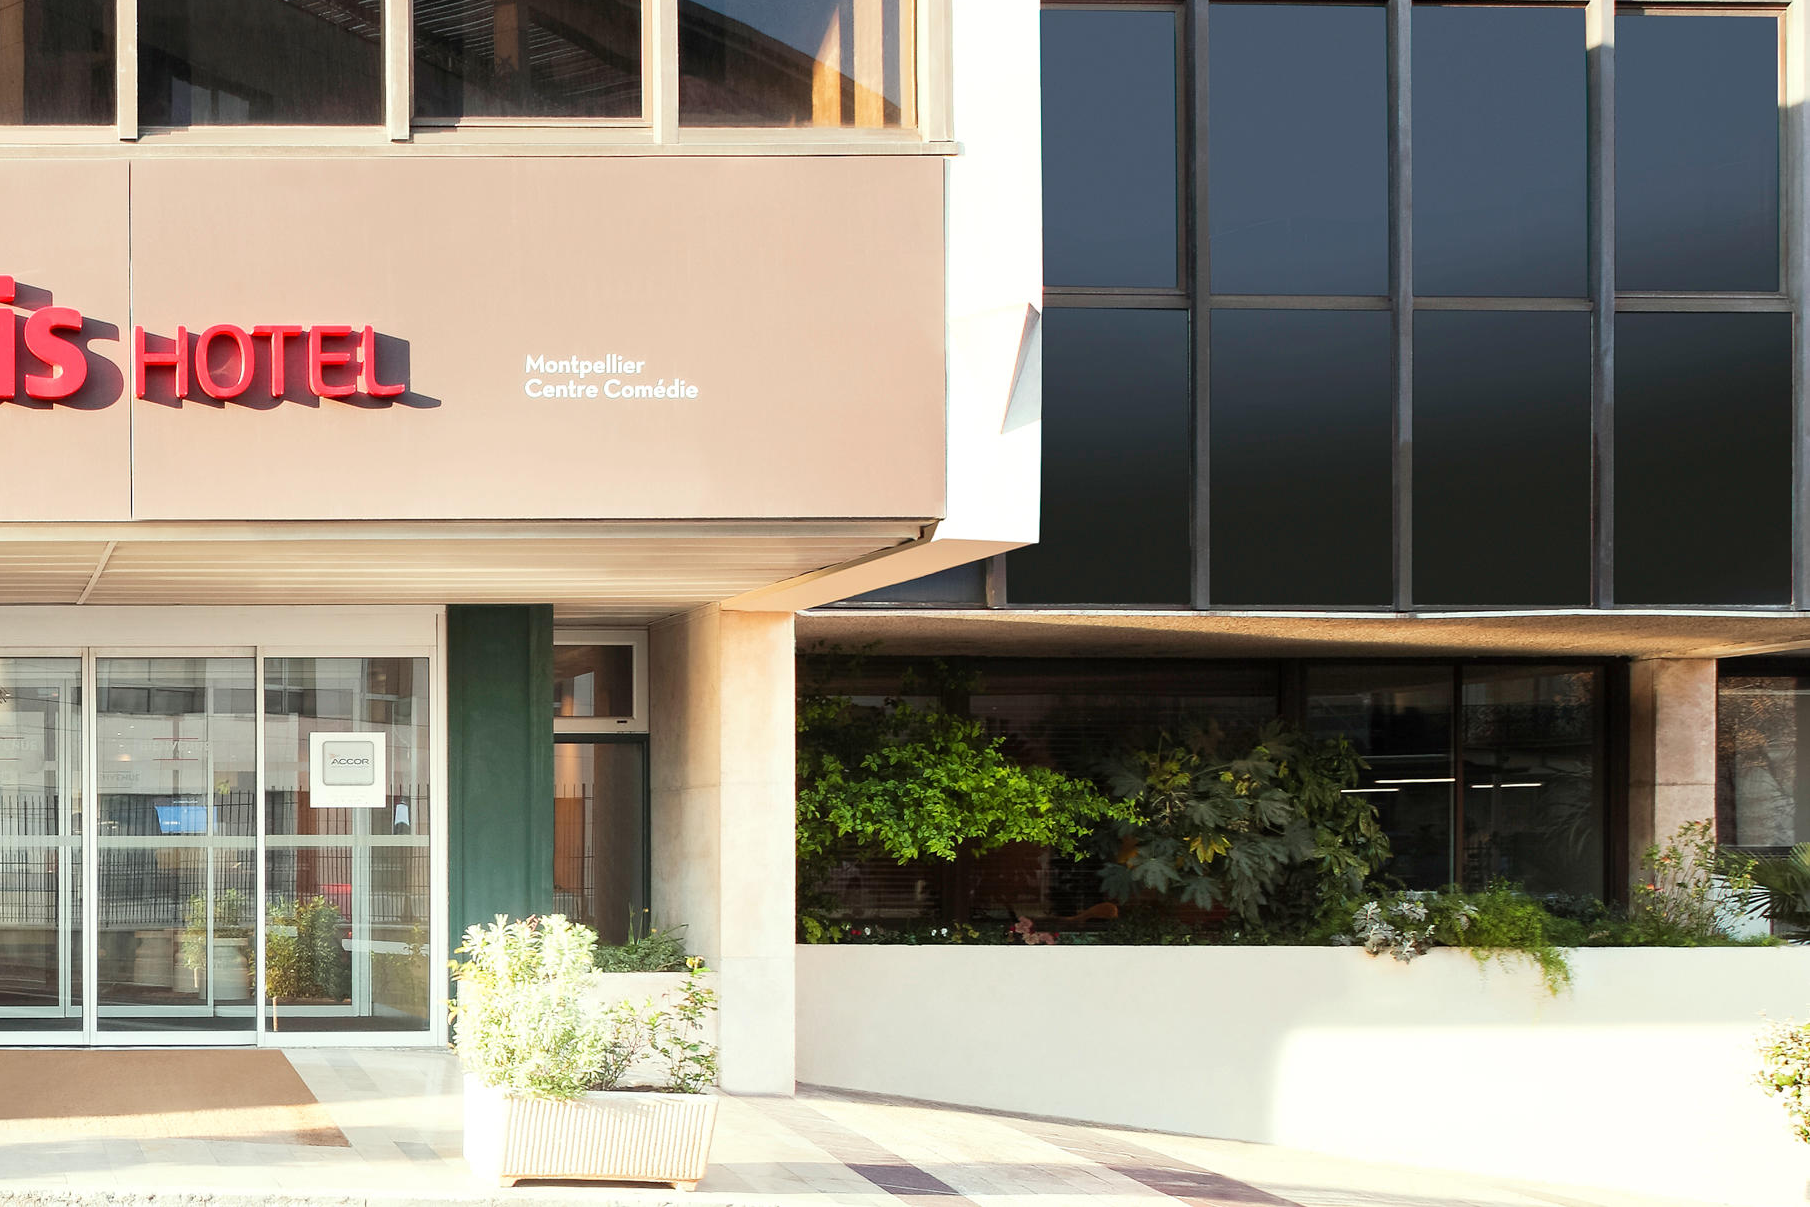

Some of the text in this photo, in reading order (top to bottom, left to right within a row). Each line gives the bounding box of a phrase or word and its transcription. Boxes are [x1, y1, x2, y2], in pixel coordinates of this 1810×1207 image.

[134, 324, 406, 400] HOTEL
[524, 353, 646, 379] Montpellier
[524, 378, 699, 399] Centre Comédie
